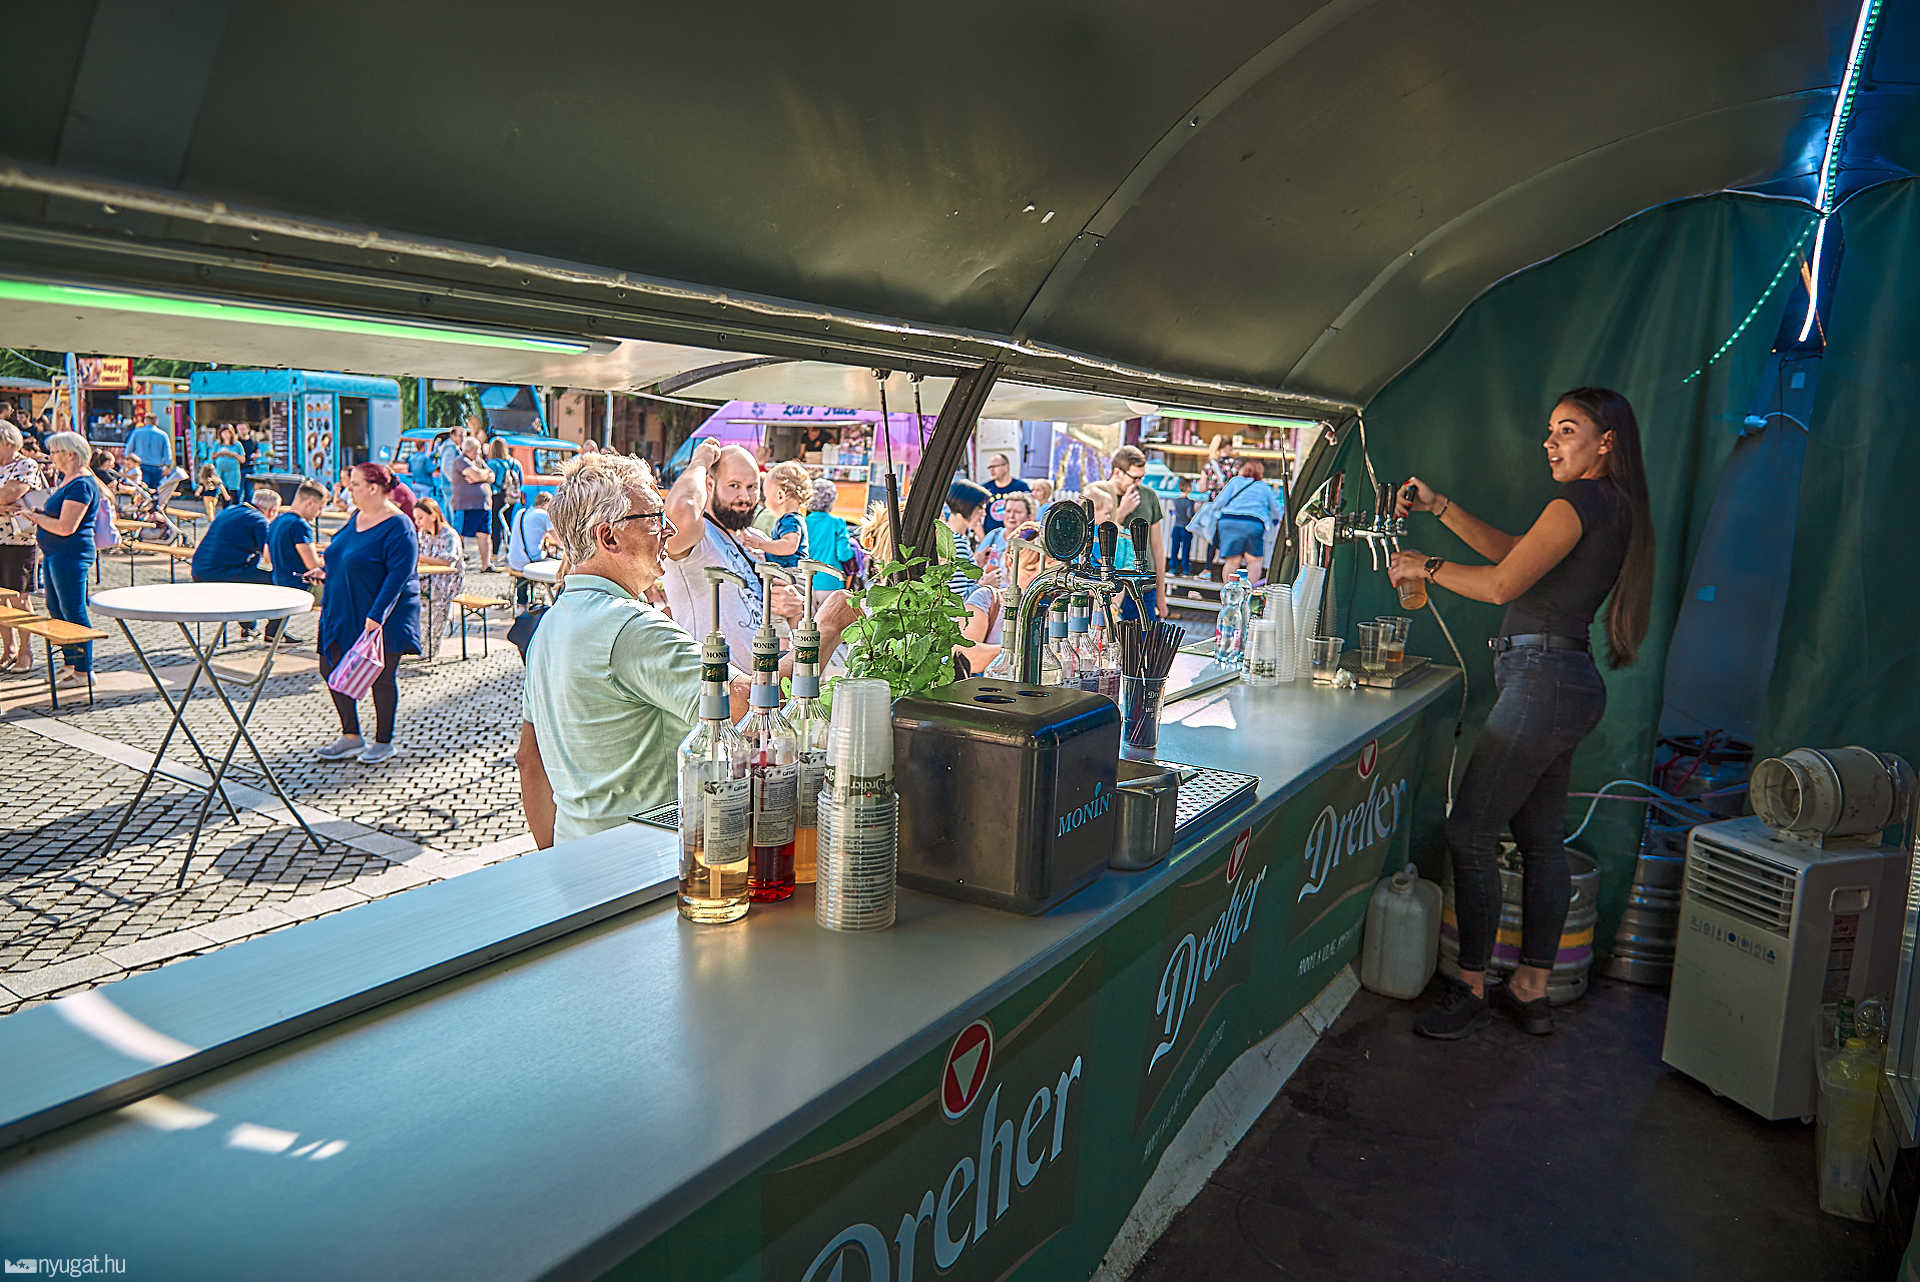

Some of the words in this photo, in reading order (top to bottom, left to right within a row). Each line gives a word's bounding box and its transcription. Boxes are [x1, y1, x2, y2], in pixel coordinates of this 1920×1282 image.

[1057, 782, 1112, 837] MONIN
[1297, 772, 1407, 904] Dreher
[1148, 864, 1267, 1076] Dreher
